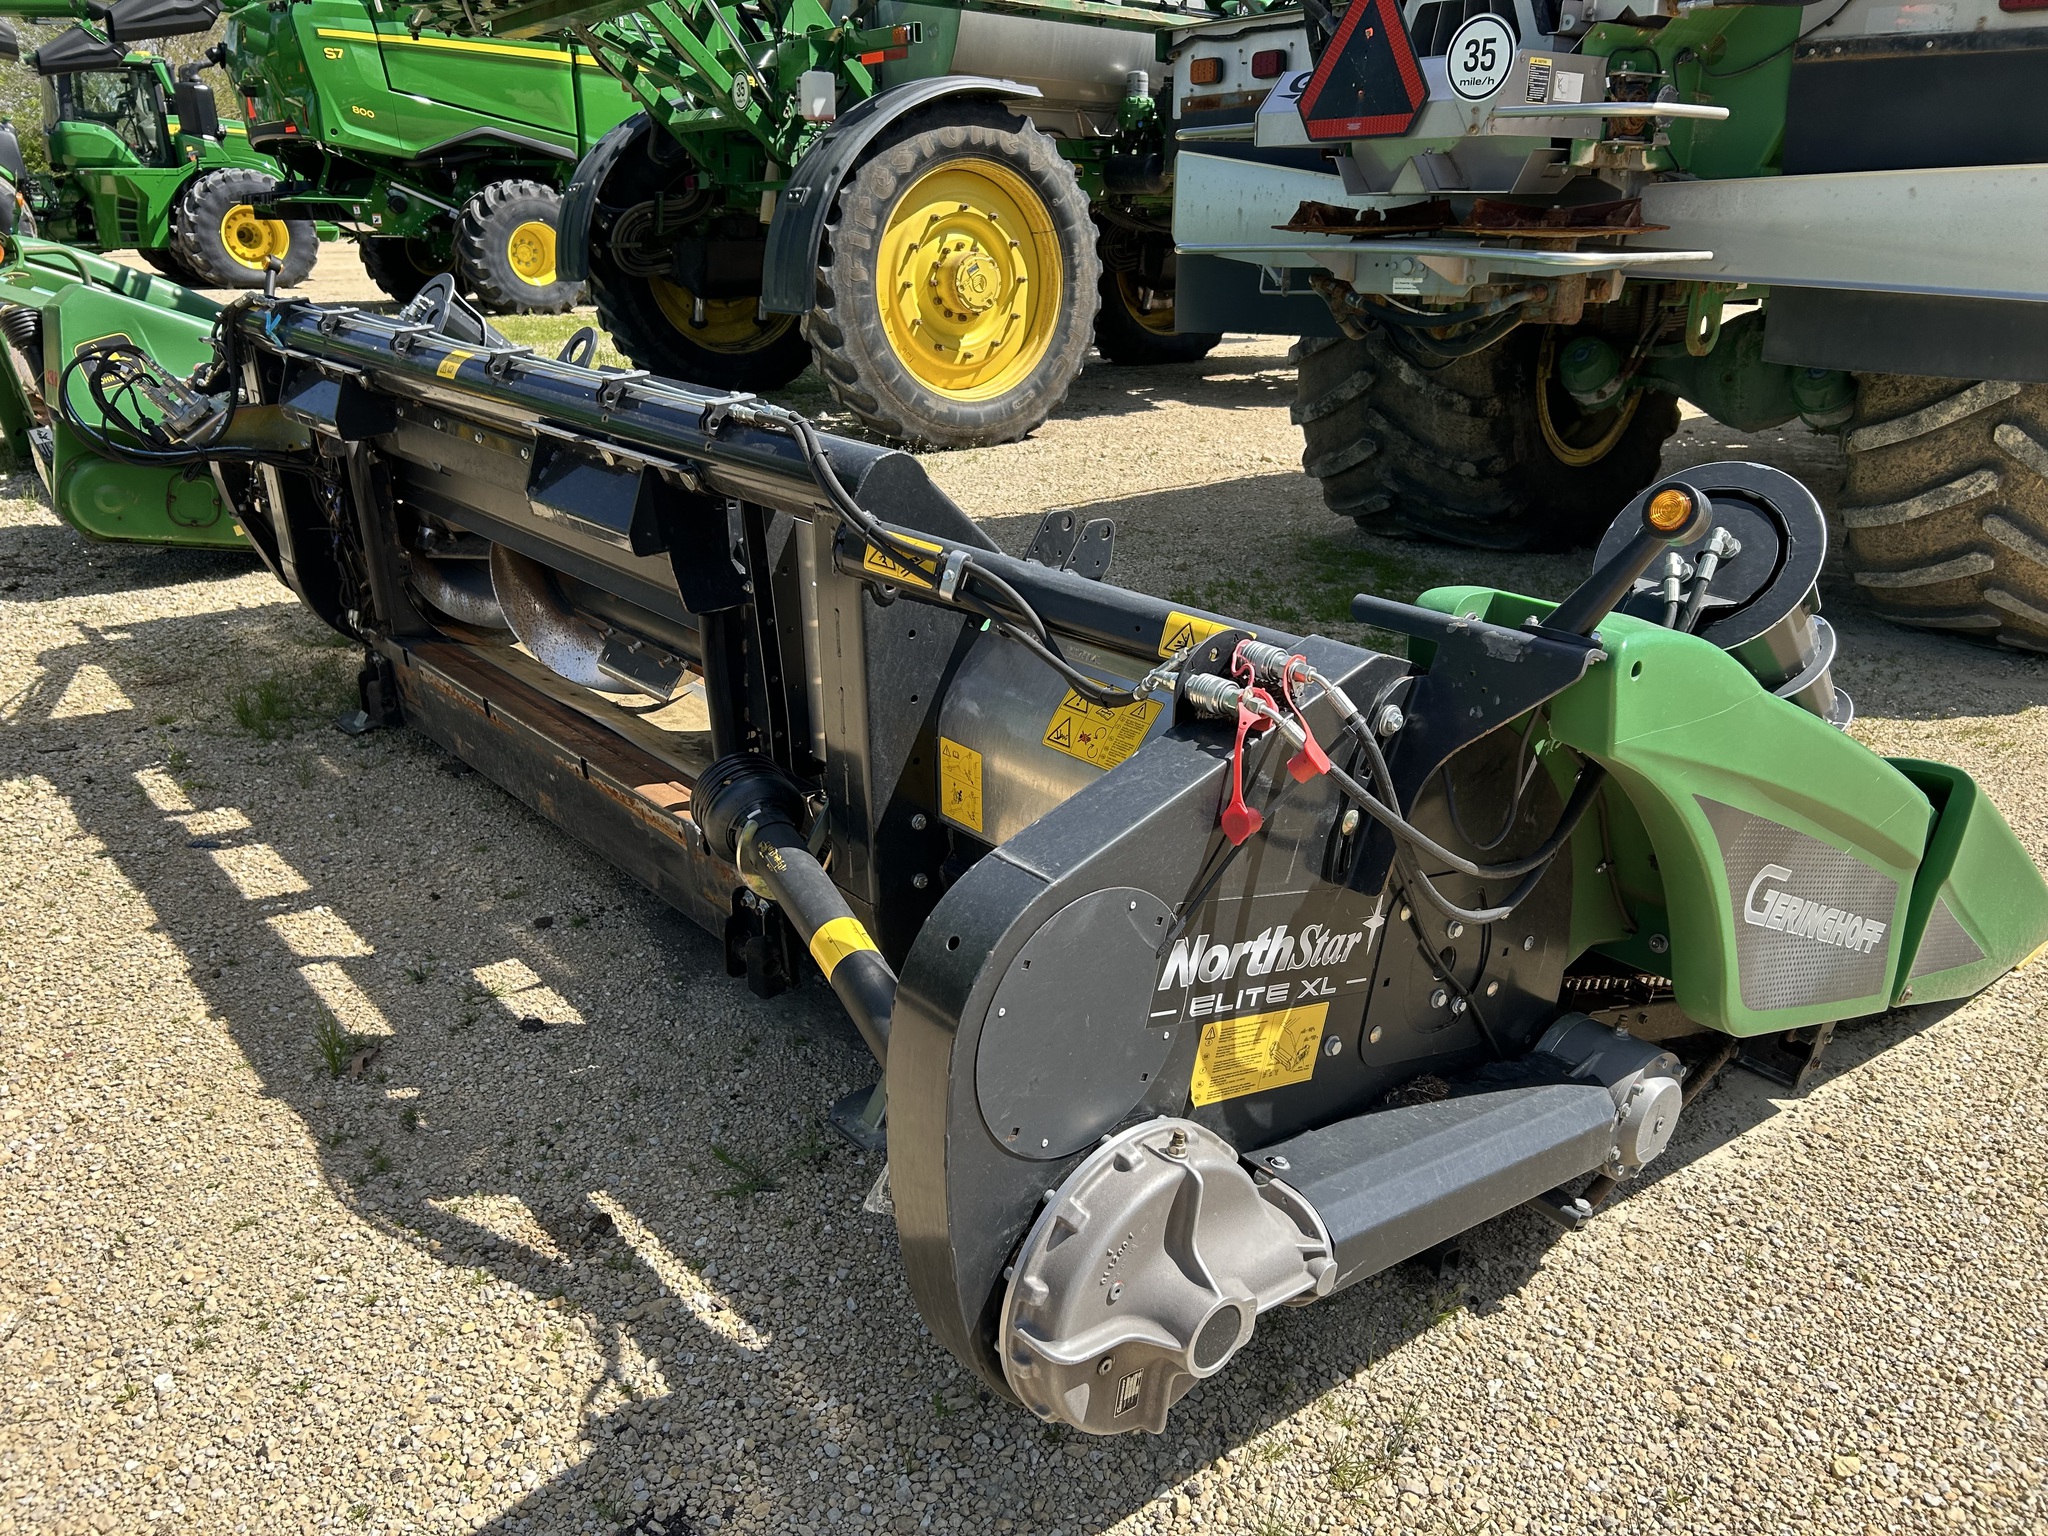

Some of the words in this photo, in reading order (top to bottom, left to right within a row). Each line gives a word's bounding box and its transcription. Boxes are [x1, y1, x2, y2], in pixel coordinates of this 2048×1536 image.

[323, 47, 344, 59] S7
[1463, 37, 1497, 73] 35
[1459, 76, 1495, 87] mile/h
[736, 82, 746, 97] 35
[352, 105, 375, 119] 800
[100, 374, 117, 385] OHN
[1743, 863, 1887, 954] GERINGHOFF
[1157, 923, 1363, 992] NorthStar
[1189, 983, 1291, 1018] ELITE
[1297, 976, 1337, 999] XL
